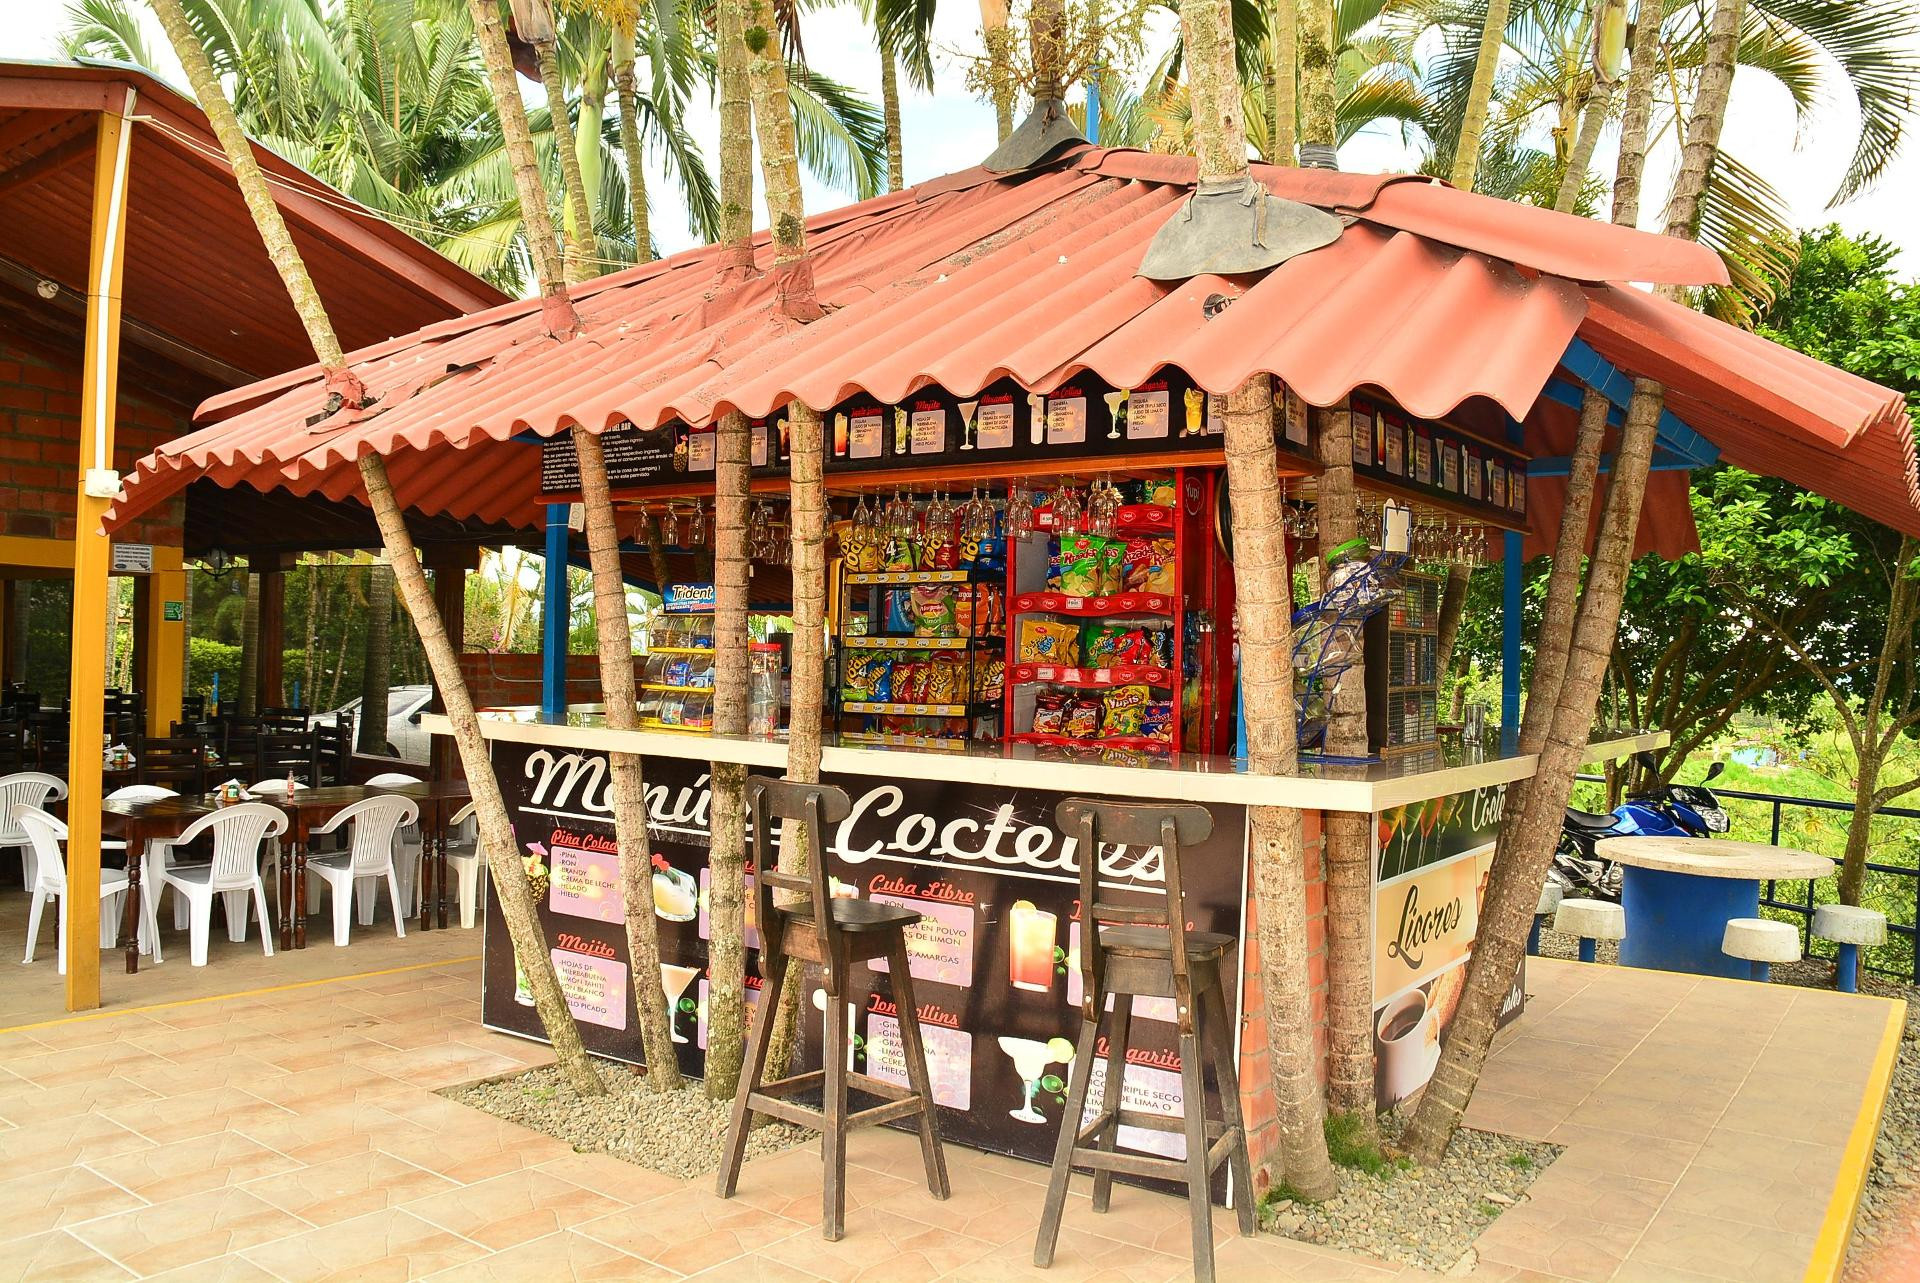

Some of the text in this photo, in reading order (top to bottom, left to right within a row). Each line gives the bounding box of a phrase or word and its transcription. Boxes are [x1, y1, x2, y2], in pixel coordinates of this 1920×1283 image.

[1186, 483, 1200, 502] Yupi
[672, 584, 713, 601] Trident
[1109, 695, 1139, 709] Yupis
[525, 749, 711, 826] Mnú
[551, 829, 580, 846] Piña
[595, 880, 616, 890] LECHE
[869, 874, 975, 903] Cuba Libre
[921, 914, 938, 924] OLA
[921, 924, 933, 932] EN
[936, 926, 967, 938] POLVO
[1387, 884, 1464, 970] Licores
[916, 932, 928, 941] DE
[558, 933, 615, 957] Mojito
[914, 951, 960, 965] AMARGAS
[565, 992, 586, 1001] ZUCAR
[581, 1003, 607, 1014] PICADO
[916, 1004, 959, 1026] ollins
[879, 1048, 904, 1057] -LIMO
[1123, 1085, 1149, 1097] RIPLE
[1152, 1091, 1182, 1104] SECO
[1087, 1097, 1103, 1107] LIM
[1135, 1097, 1159, 1109] LIMA
[1162, 1103, 1172, 1112] O
